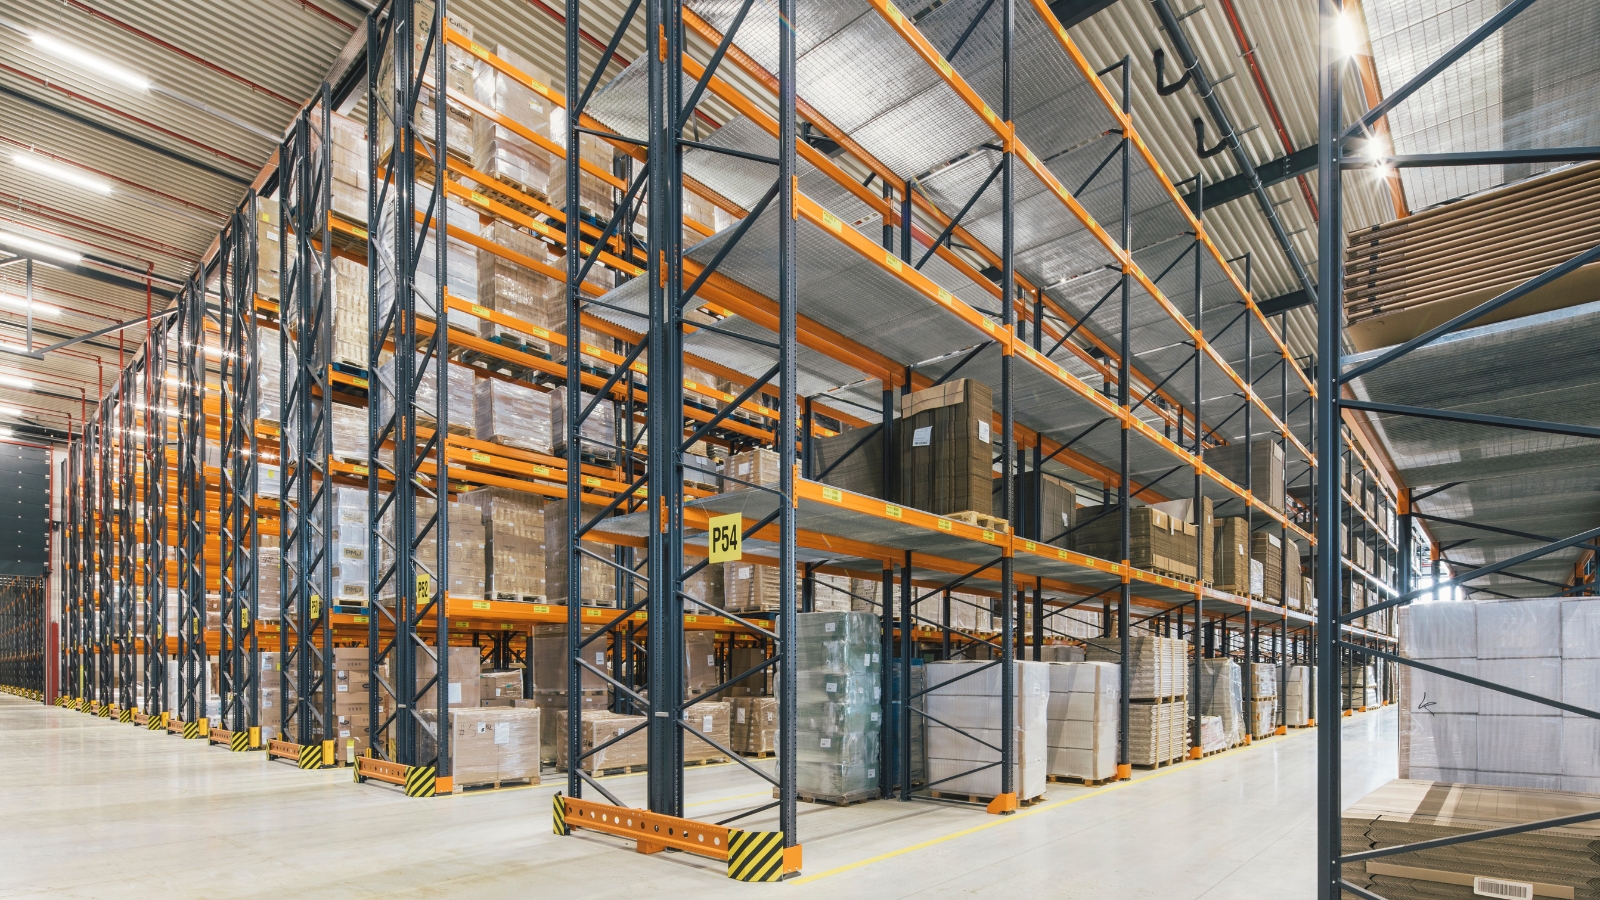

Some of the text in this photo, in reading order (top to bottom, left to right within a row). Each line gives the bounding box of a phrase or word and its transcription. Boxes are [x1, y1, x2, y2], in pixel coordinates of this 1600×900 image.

[449, 107, 471, 122] Cullen
[712, 524, 737, 553] P54
[345, 549, 362, 557] PMJ
[417, 580, 428, 598] P52
